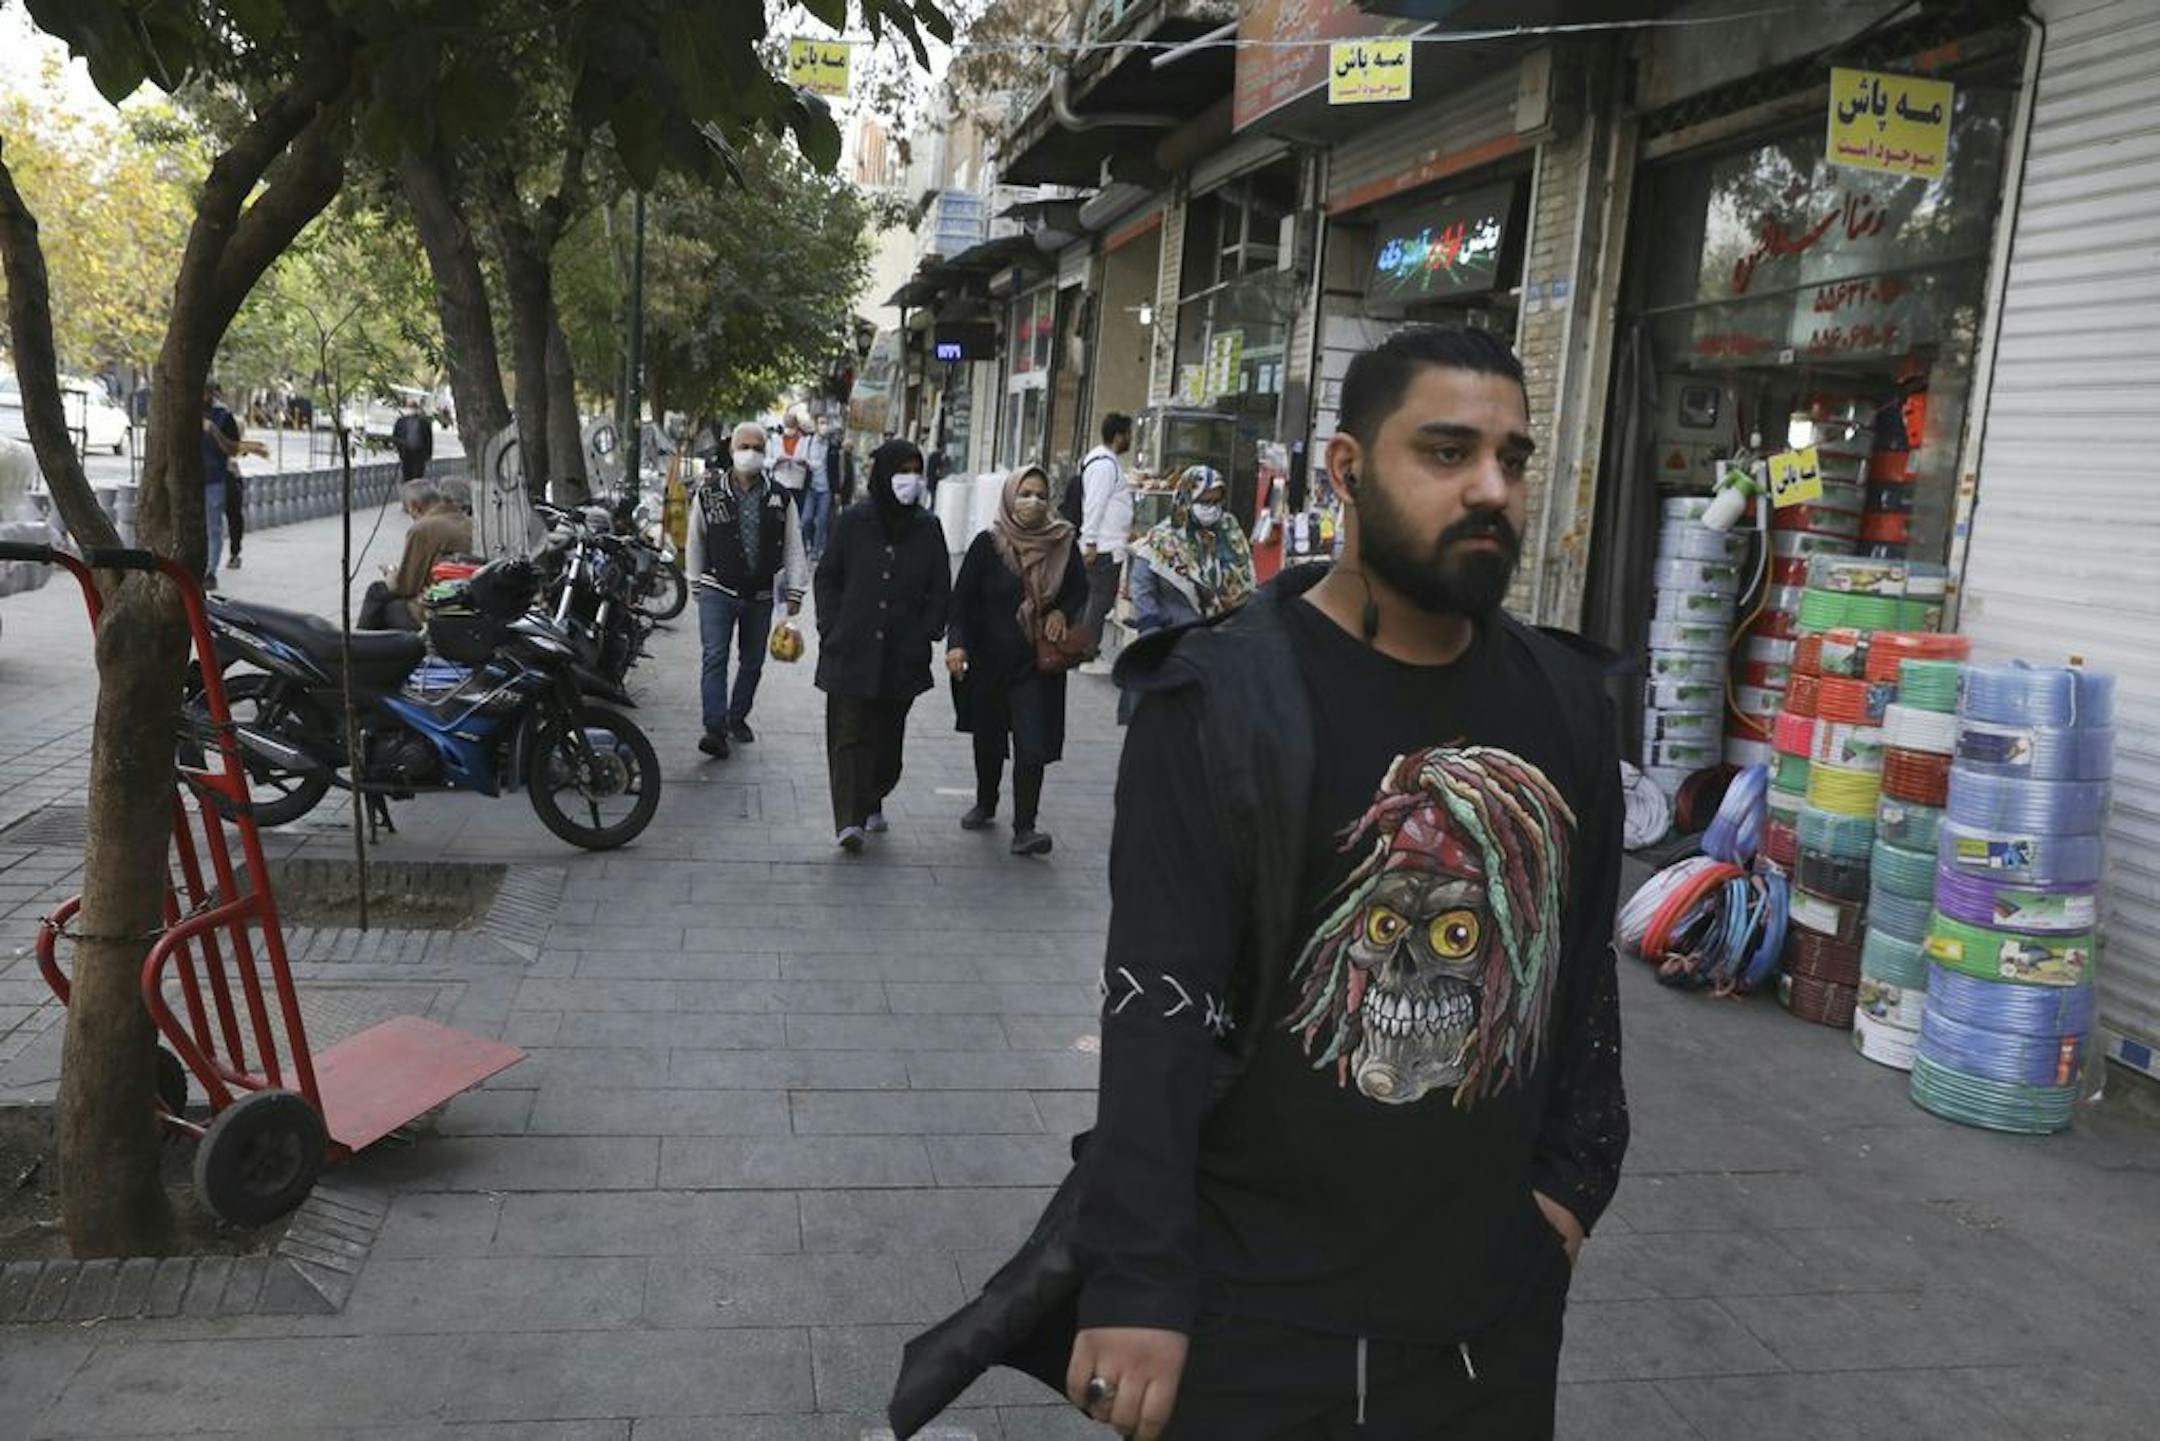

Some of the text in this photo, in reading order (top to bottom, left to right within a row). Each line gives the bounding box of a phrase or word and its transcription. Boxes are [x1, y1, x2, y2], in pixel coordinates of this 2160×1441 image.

[1336, 46, 1405, 77] مه پاش
[1837, 77, 1942, 131] مه پاش
[1875, 144, 1937, 170] موجود
